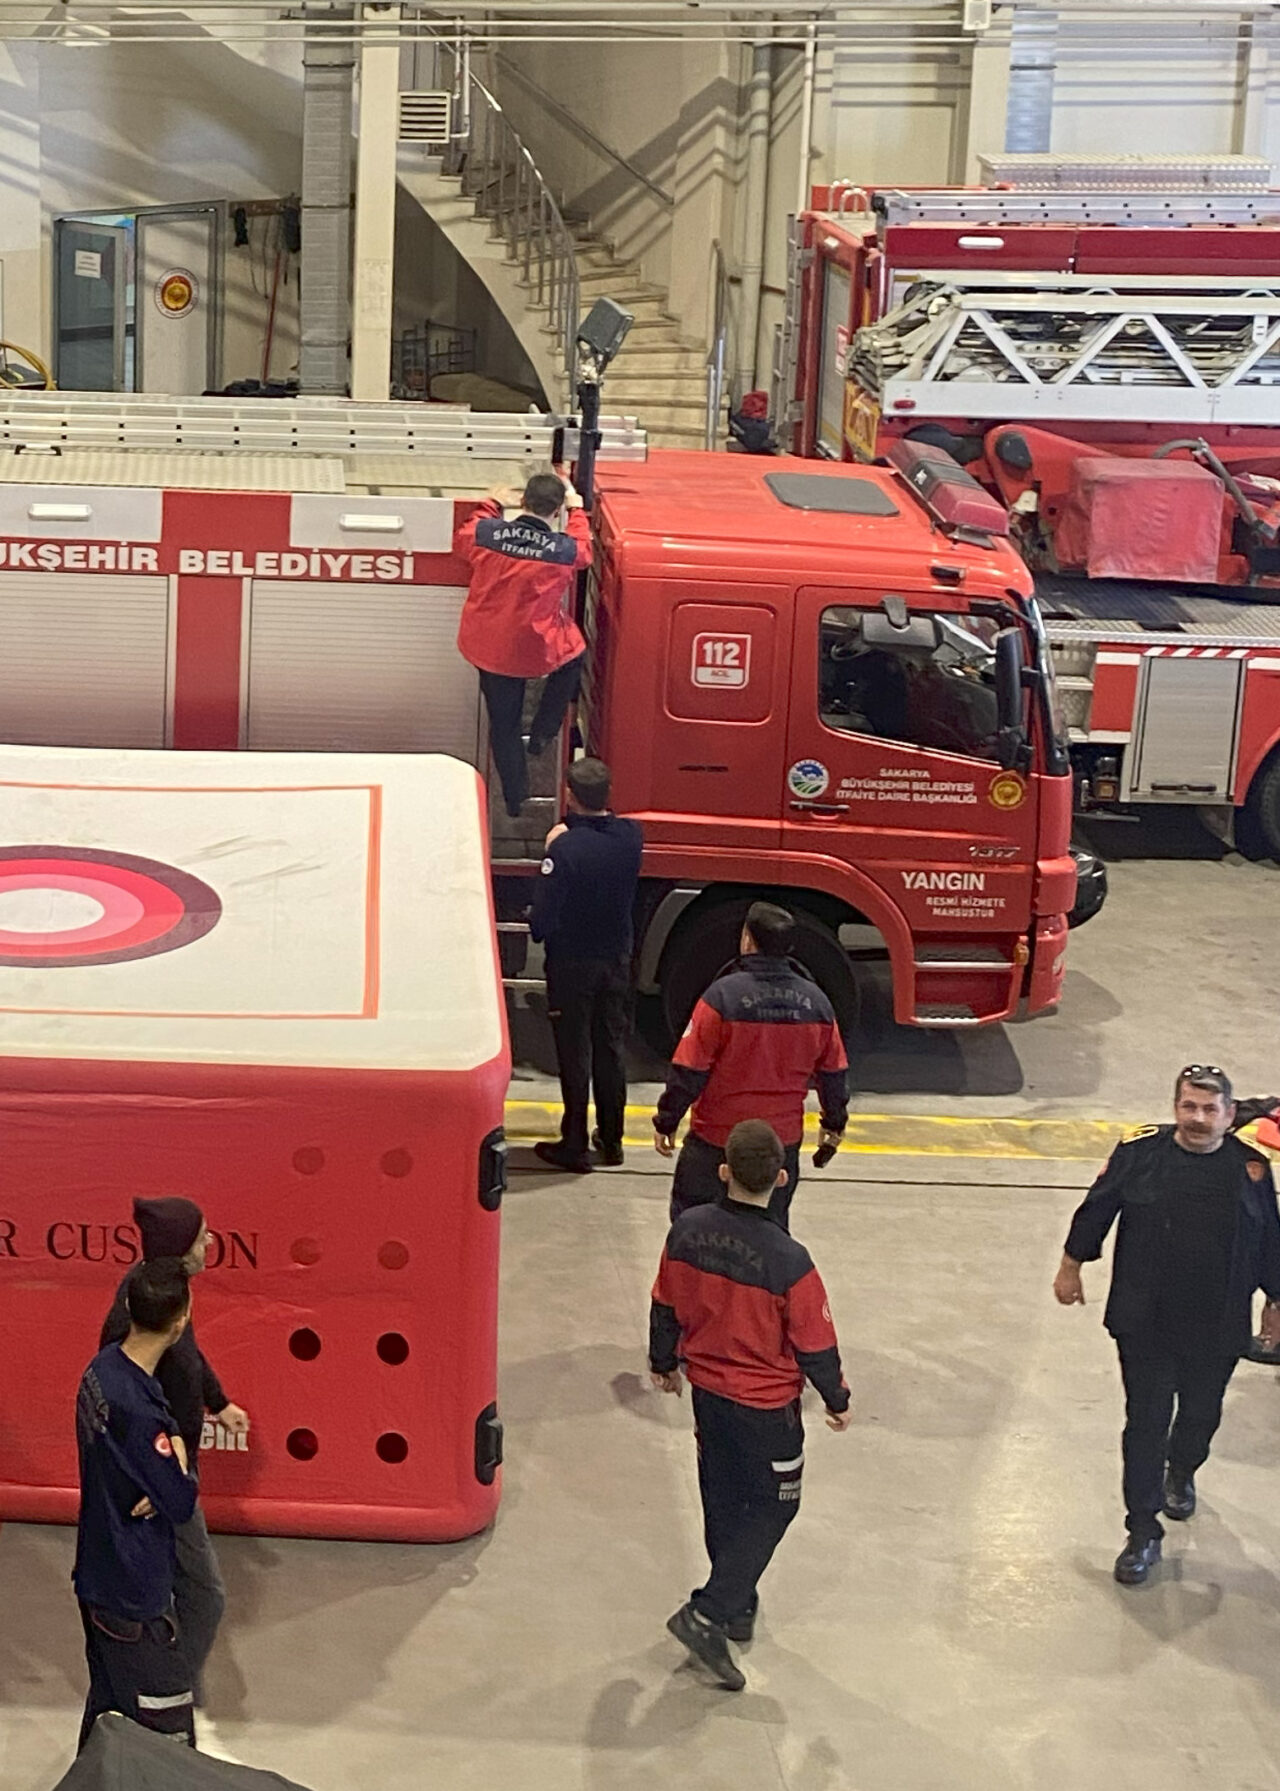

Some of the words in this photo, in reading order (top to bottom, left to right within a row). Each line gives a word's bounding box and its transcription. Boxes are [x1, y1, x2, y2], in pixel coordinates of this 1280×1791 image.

[493, 527, 557, 552] SAKARYA
[179, 547, 414, 579] BELEDİYESİ
[702, 641, 740, 666] 112
[880, 768, 930, 778] SAKARYA
[901, 871, 985, 891] YANGIN
[46, 1222, 260, 1270] CUSON
